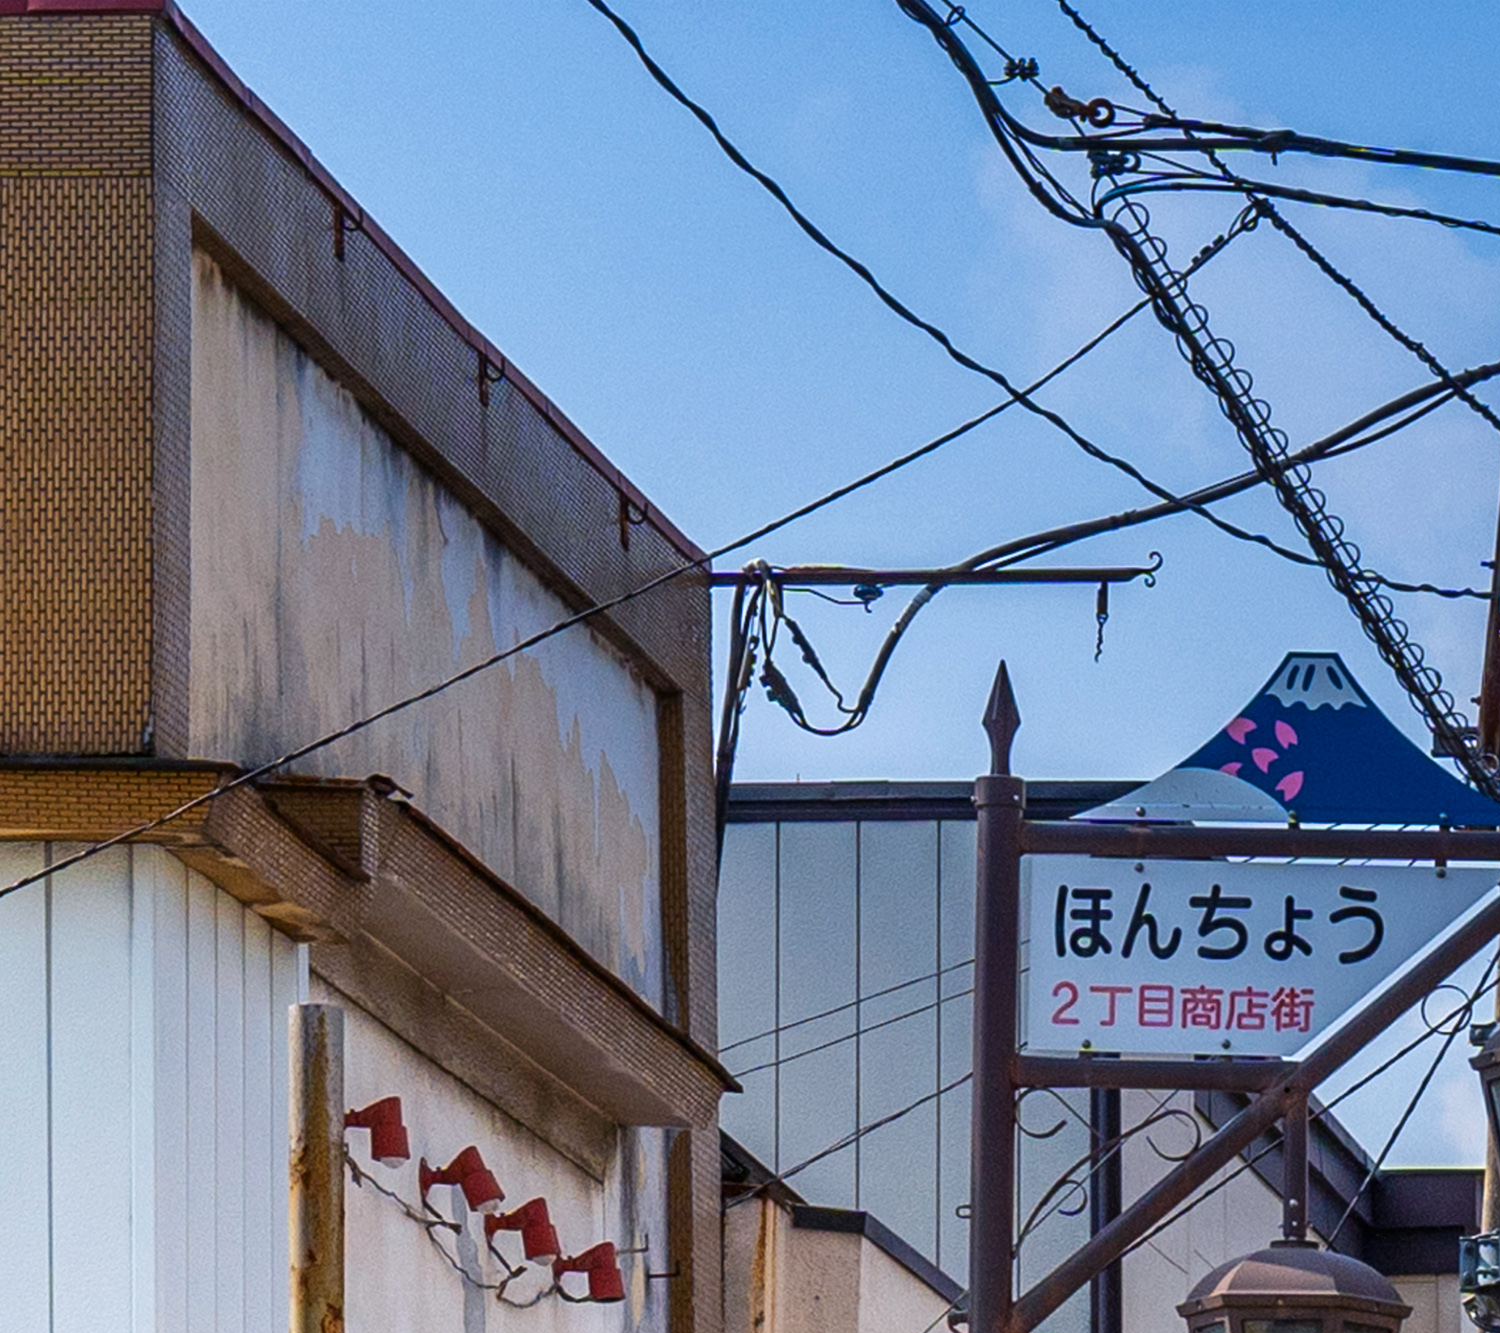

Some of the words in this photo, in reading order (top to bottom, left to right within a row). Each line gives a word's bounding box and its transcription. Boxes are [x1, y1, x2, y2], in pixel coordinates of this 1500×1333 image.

[1052, 882, 1387, 964] ほんちょう
[1051, 984, 1316, 1034] 2丁目商店街
